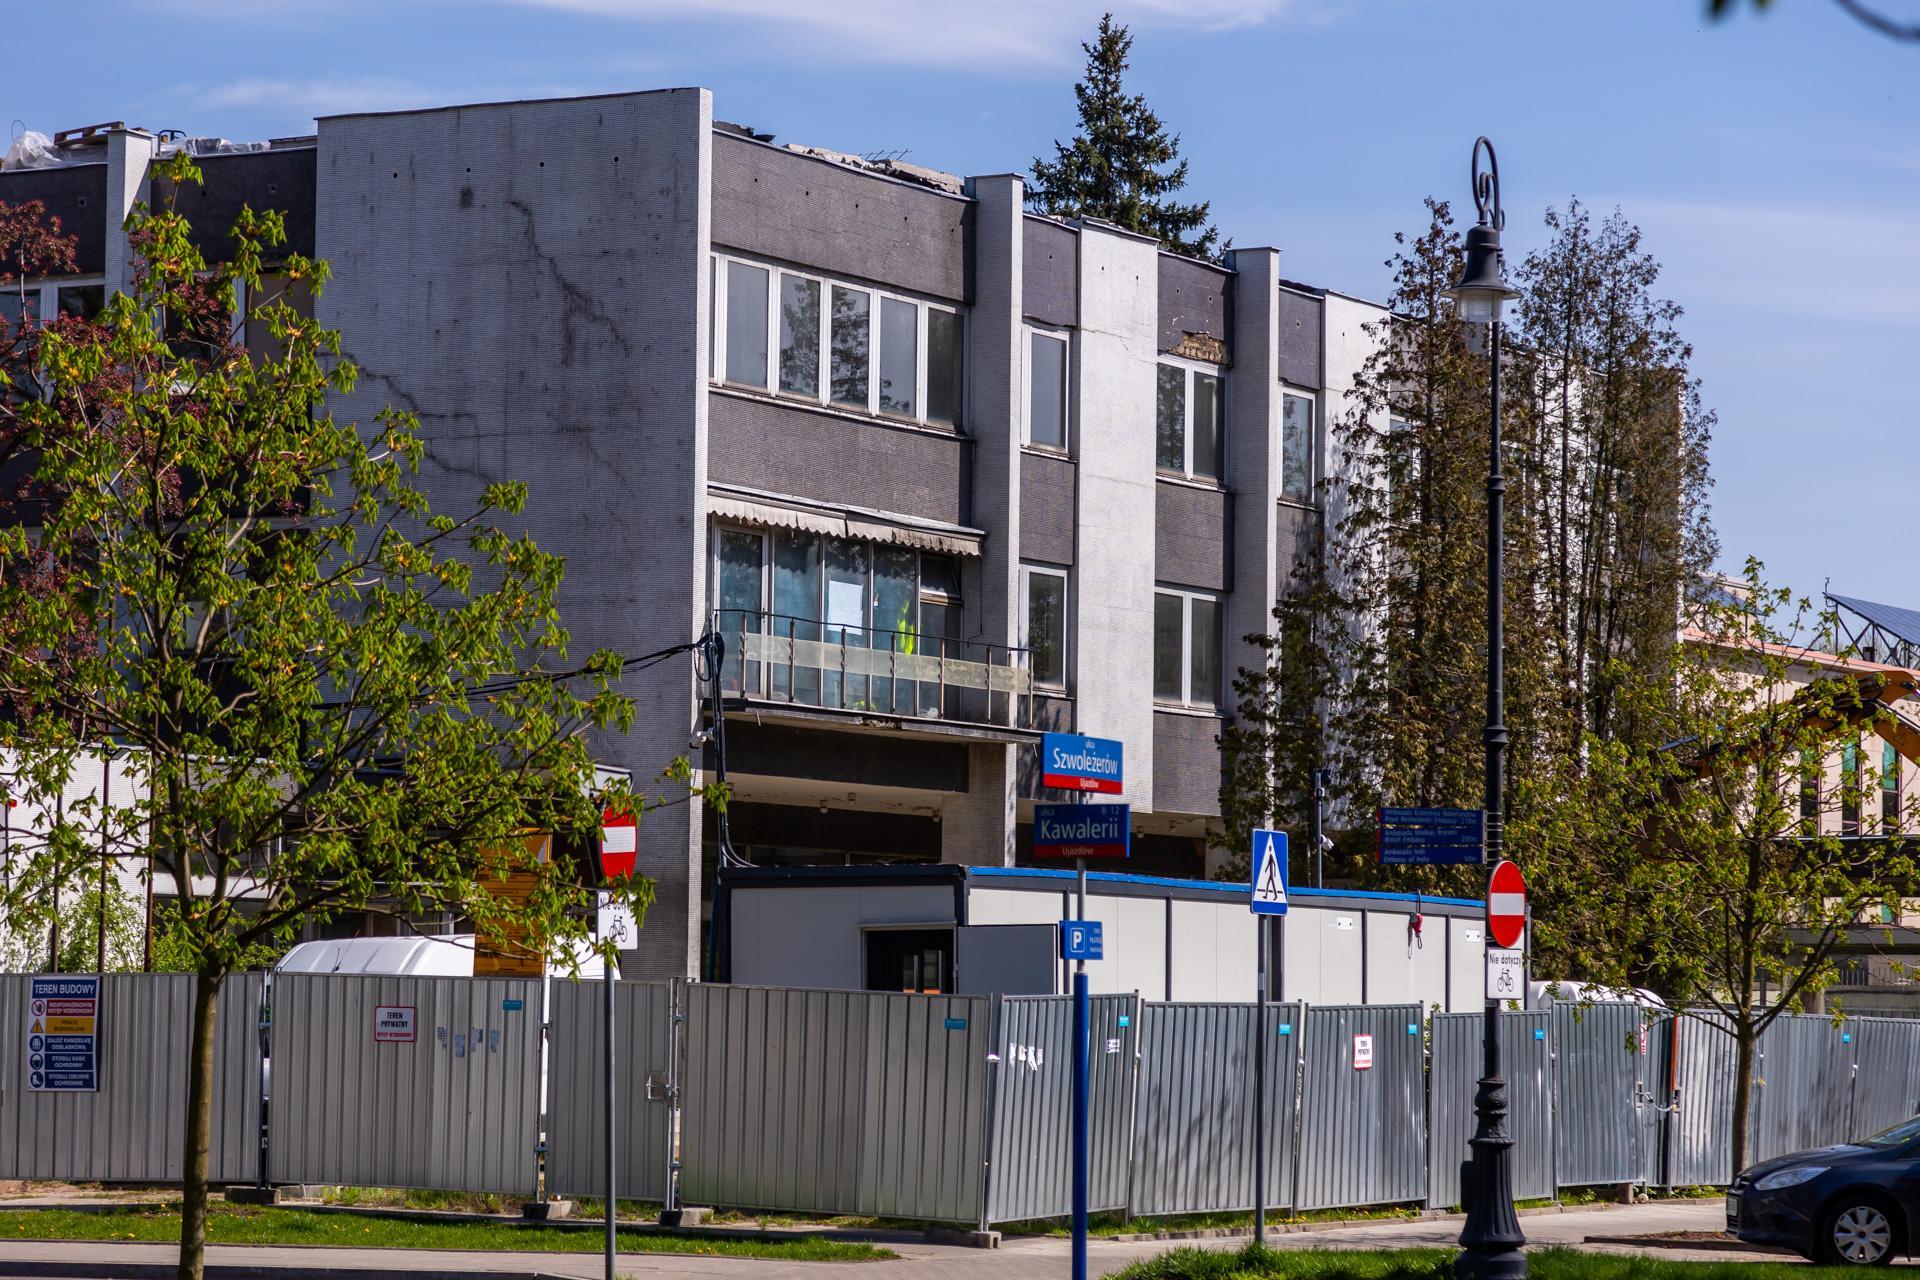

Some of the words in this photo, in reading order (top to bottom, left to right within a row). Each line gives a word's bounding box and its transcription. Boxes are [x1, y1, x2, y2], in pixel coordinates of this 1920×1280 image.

[1085, 739, 1096, 749] ulica
[1053, 747, 1118, 775] Szwoleżerów
[1080, 778, 1099, 789] Ujazdów
[1041, 817, 1118, 839] Kawalerii
[1062, 846, 1094, 857] Ujazdów
[1073, 931, 1082, 949] P
[1490, 953, 1499, 964] Nie
[1501, 954, 1521, 968] dotyczy
[34, 984, 58, 994] TEREN
[60, 984, 95, 994] BUDOWY
[387, 1011, 403, 1020] TEREN
[381, 1020, 408, 1028] PRYWATNY
